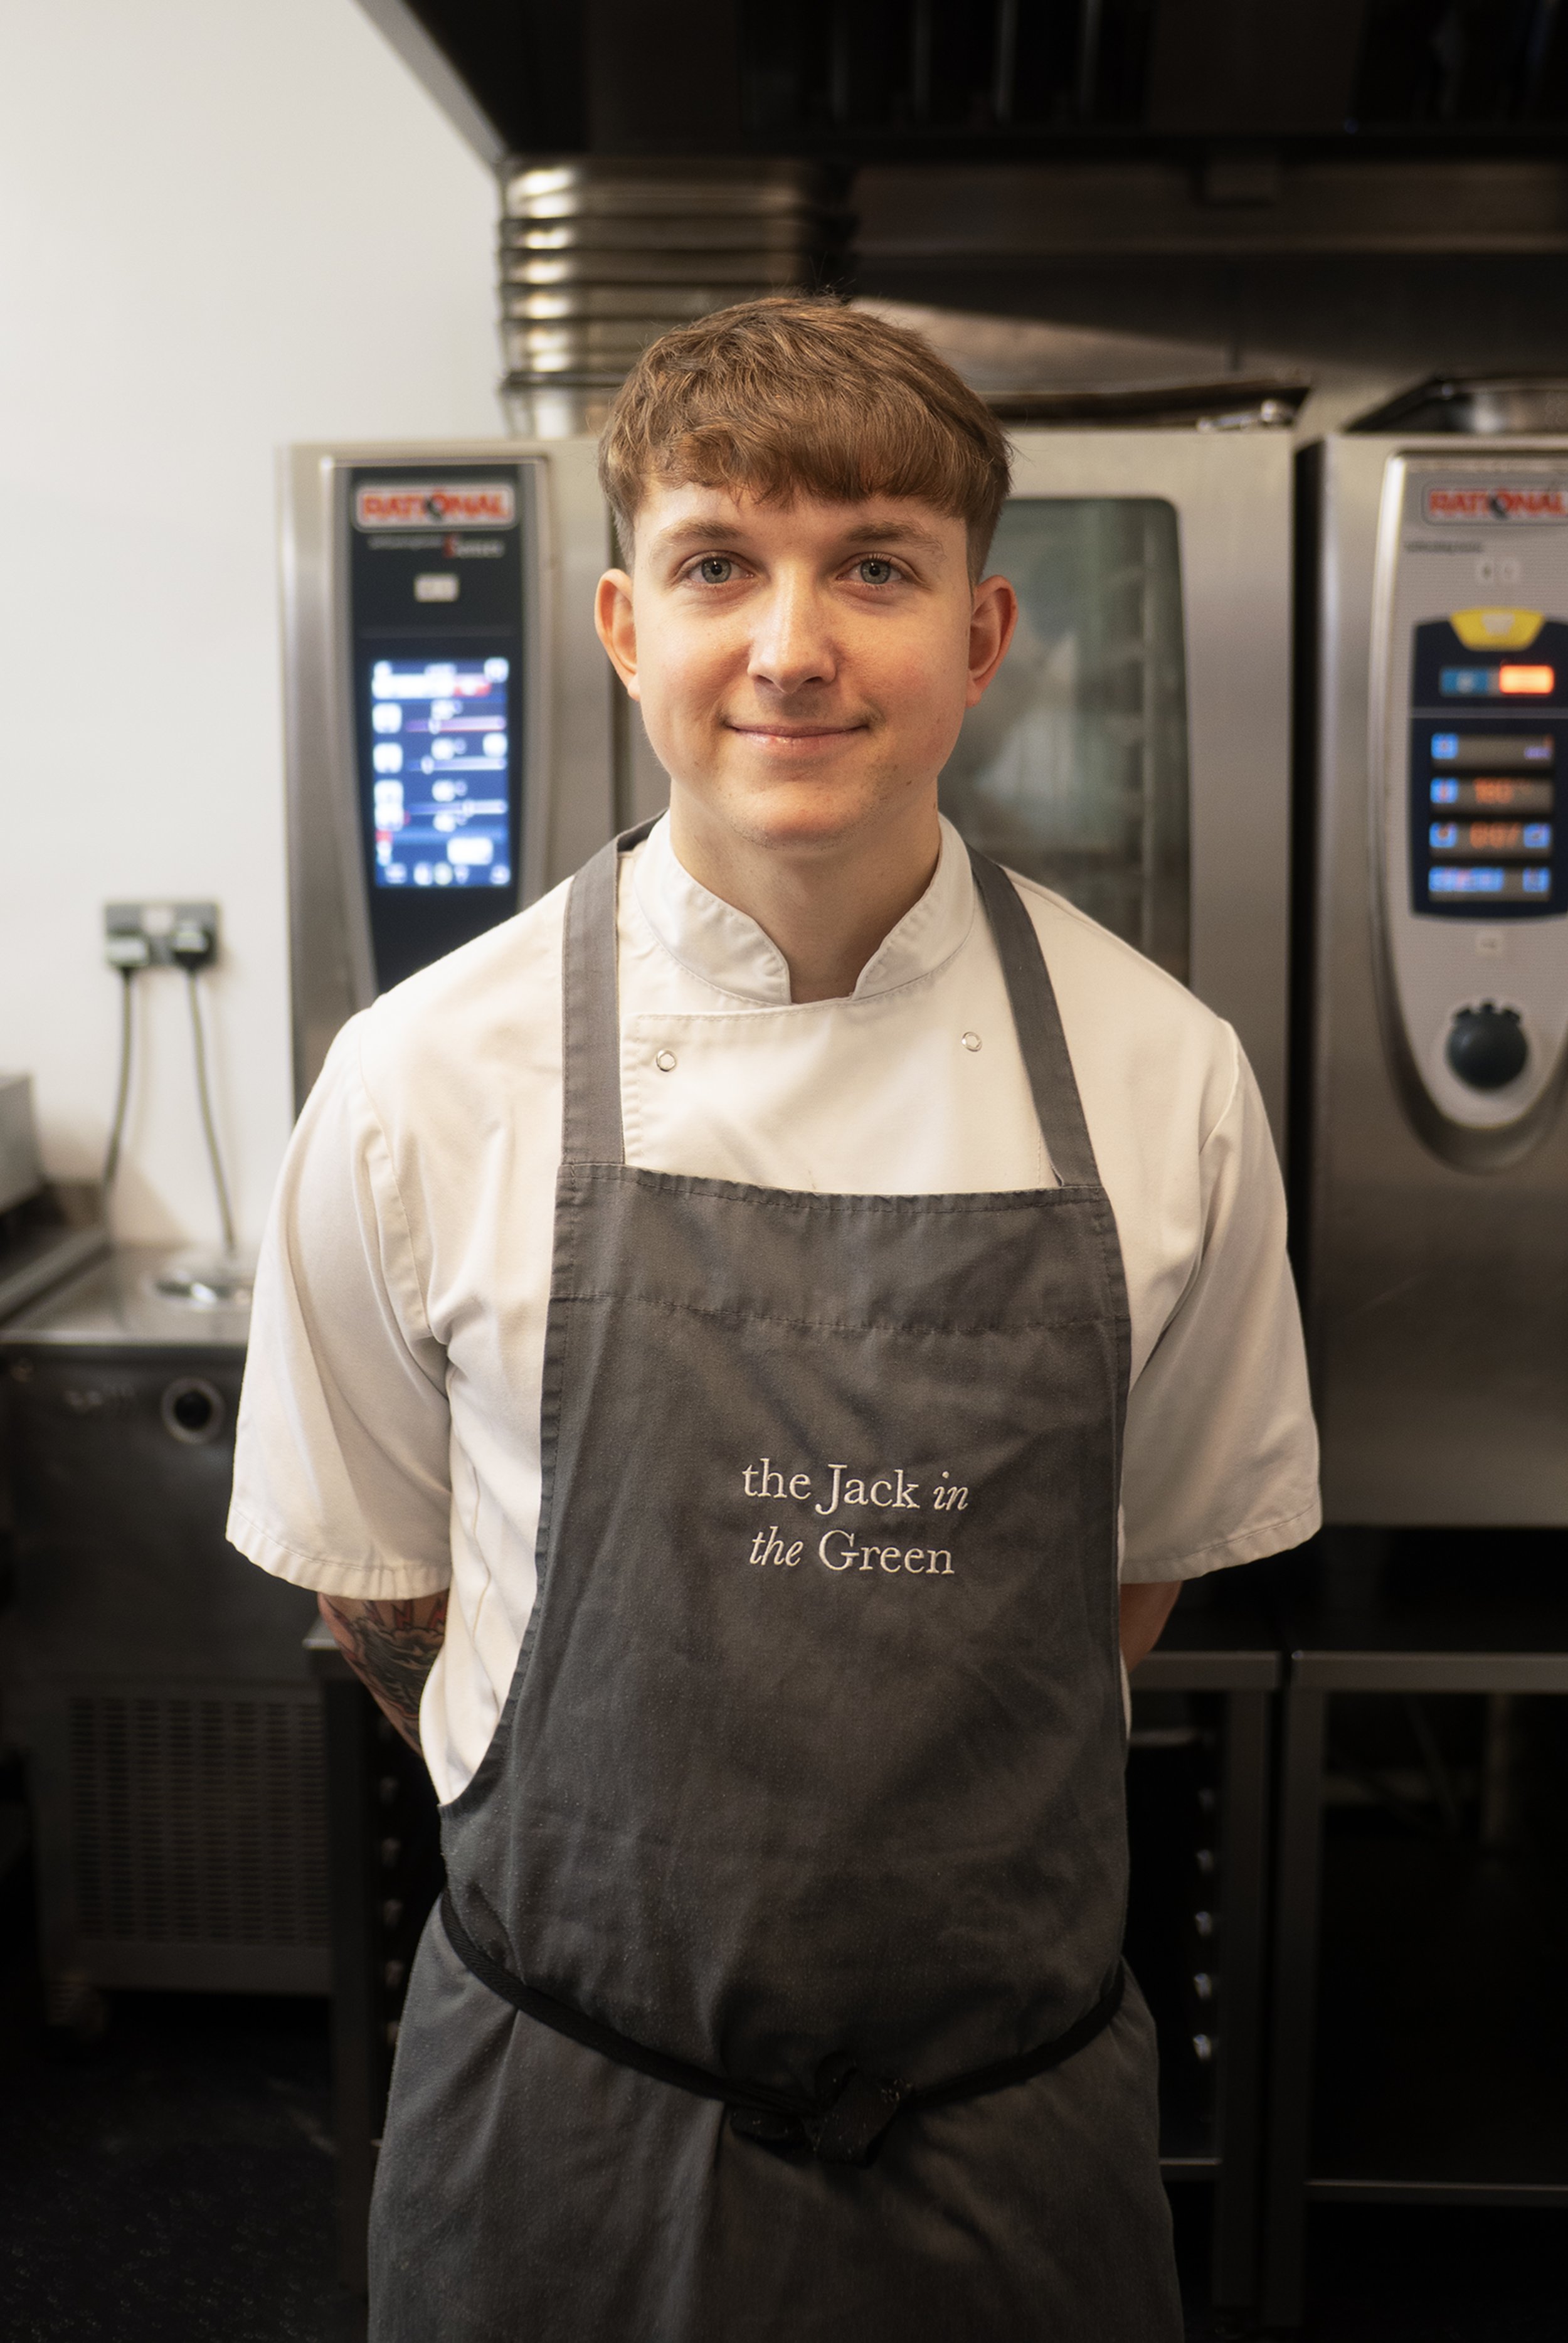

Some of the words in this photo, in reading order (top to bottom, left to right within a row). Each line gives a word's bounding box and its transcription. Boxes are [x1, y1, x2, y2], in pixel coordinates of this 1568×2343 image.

[363, 489, 509, 521] RATIONAL
[742, 1458, 811, 1500] the
[815, 1464, 920, 1515] Jack
[933, 1471, 969, 1511] in
[750, 1526, 803, 1566] the
[818, 1530, 955, 1575] Green
